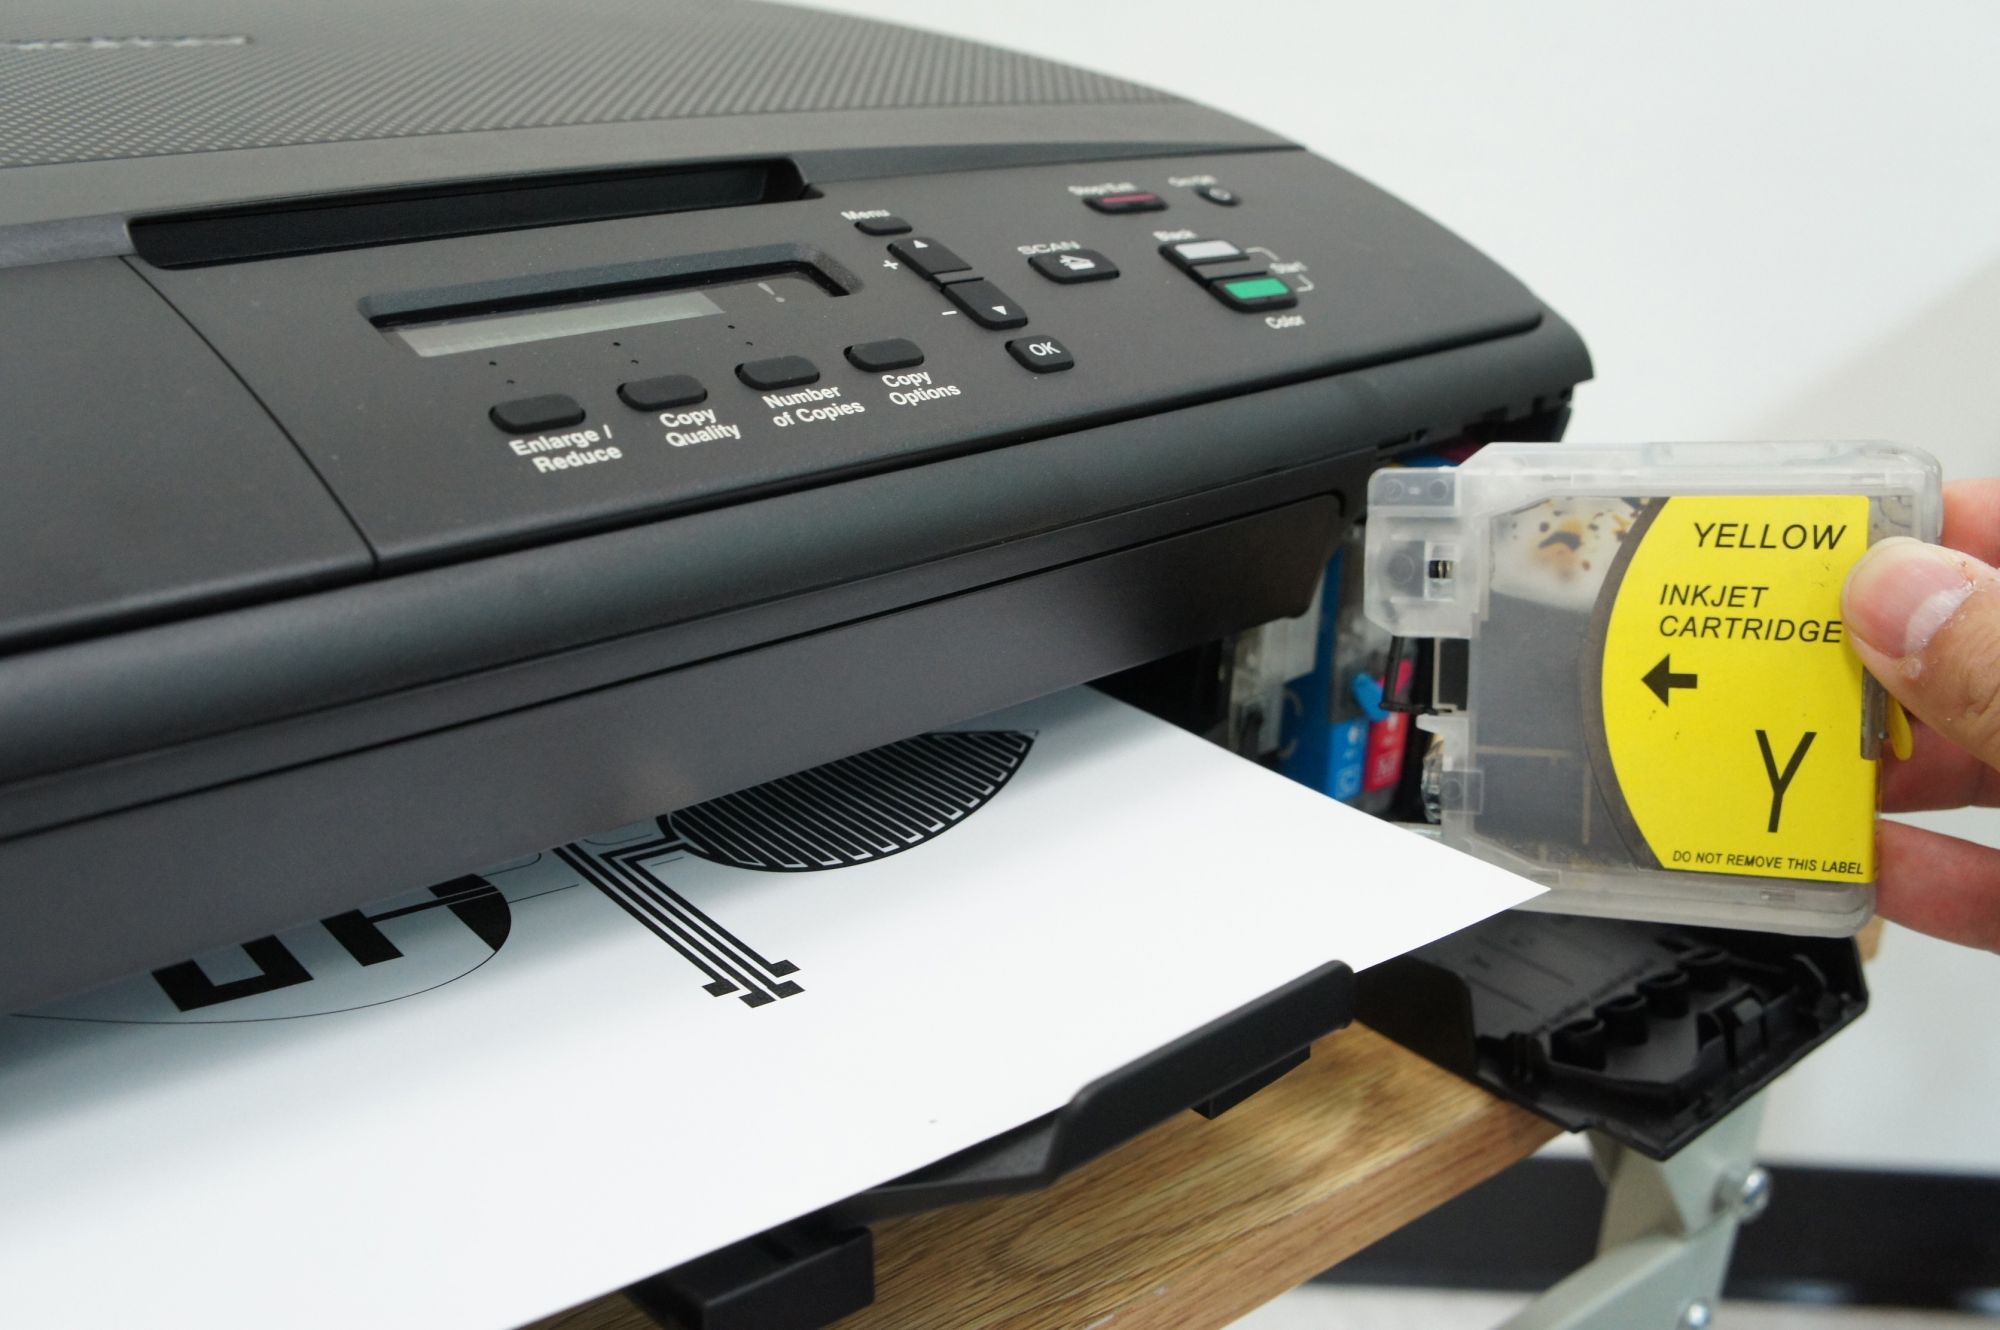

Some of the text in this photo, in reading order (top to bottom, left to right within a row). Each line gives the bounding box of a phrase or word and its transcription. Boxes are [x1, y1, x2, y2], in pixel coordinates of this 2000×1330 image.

[840, 209, 891, 221] Menu
[1017, 240, 1081, 255] SCAN
[1028, 341, 1061, 357] OK
[881, 369, 931, 389] Copy
[761, 385, 842, 410] Number
[888, 383, 962, 407] Options
[659, 408, 717, 431] Copy
[772, 400, 866, 428] of Copies
[508, 429, 600, 457] Enlarge
[665, 421, 742, 449] Quality
[532, 444, 623, 474] Reduce
[1694, 522, 1847, 551] YELLOW
[1659, 583, 1770, 609] INKJET
[1659, 615, 1843, 644] CARTRIDGE
[1756, 730, 1817, 833] Y
[1672, 849, 1864, 875] DO NOT REMOVE THIS LABEL
